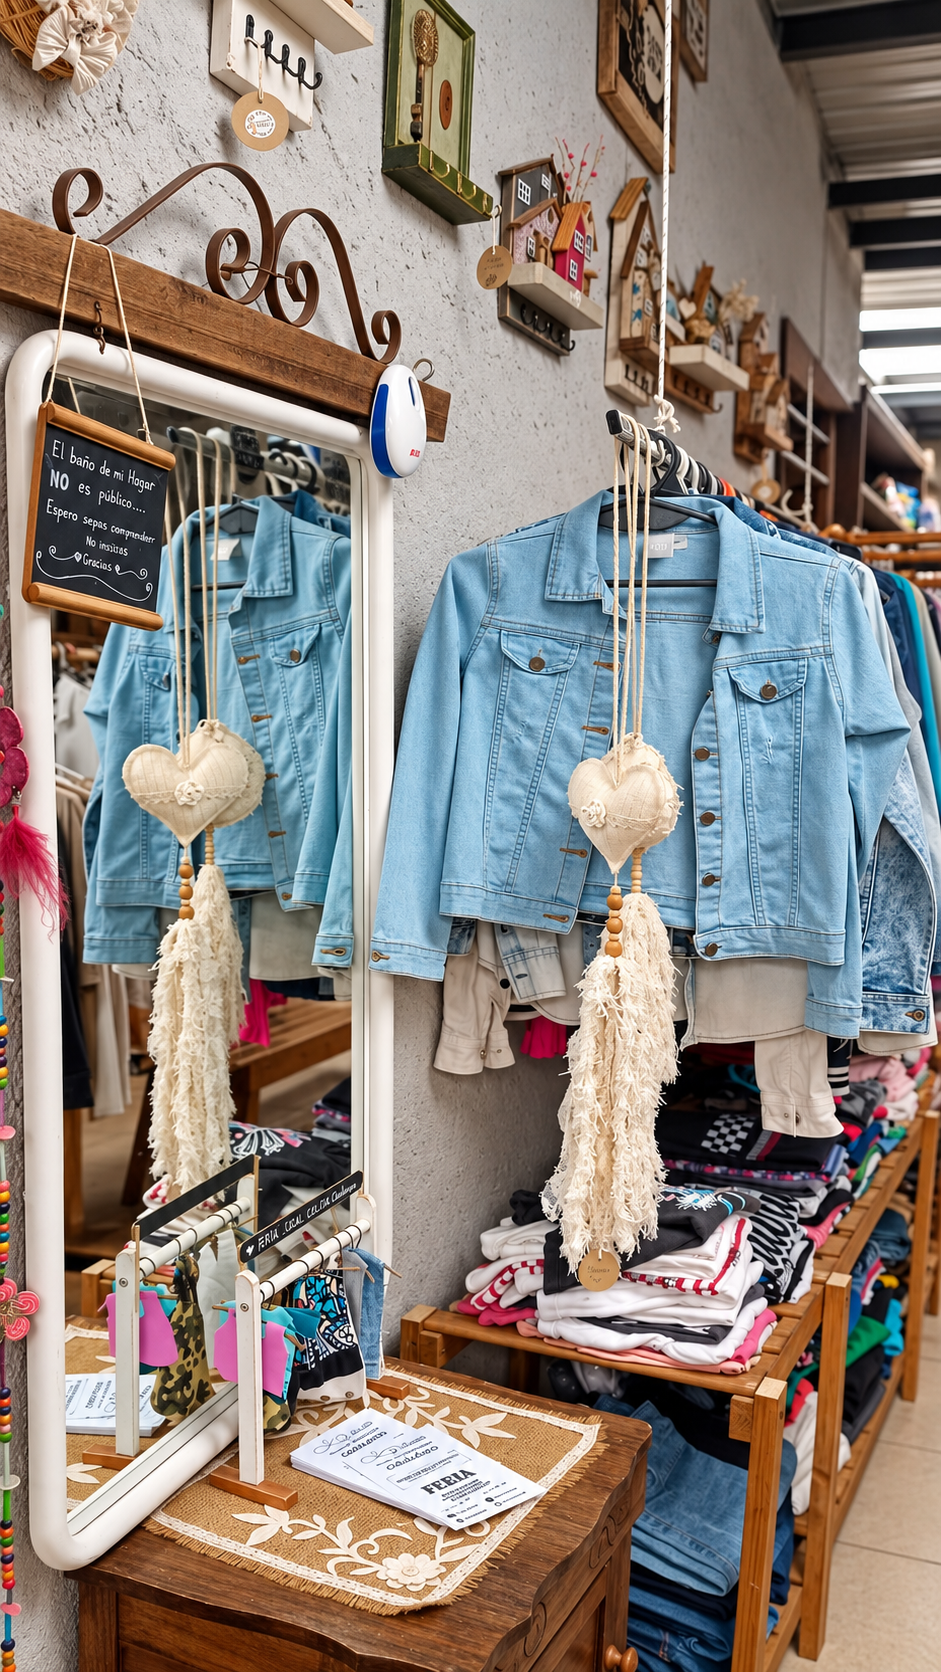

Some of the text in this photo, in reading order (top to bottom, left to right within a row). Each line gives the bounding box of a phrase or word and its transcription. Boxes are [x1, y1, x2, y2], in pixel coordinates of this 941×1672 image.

[52, 439, 155, 494] El baño de mi Hogar
[50, 469, 69, 491] NO
[78, 482, 91, 496] es
[46, 499, 78, 523] Espero
[83, 516, 108, 531] sepas
[86, 535, 96, 547] No
[83, 553, 112, 571] Gracias
